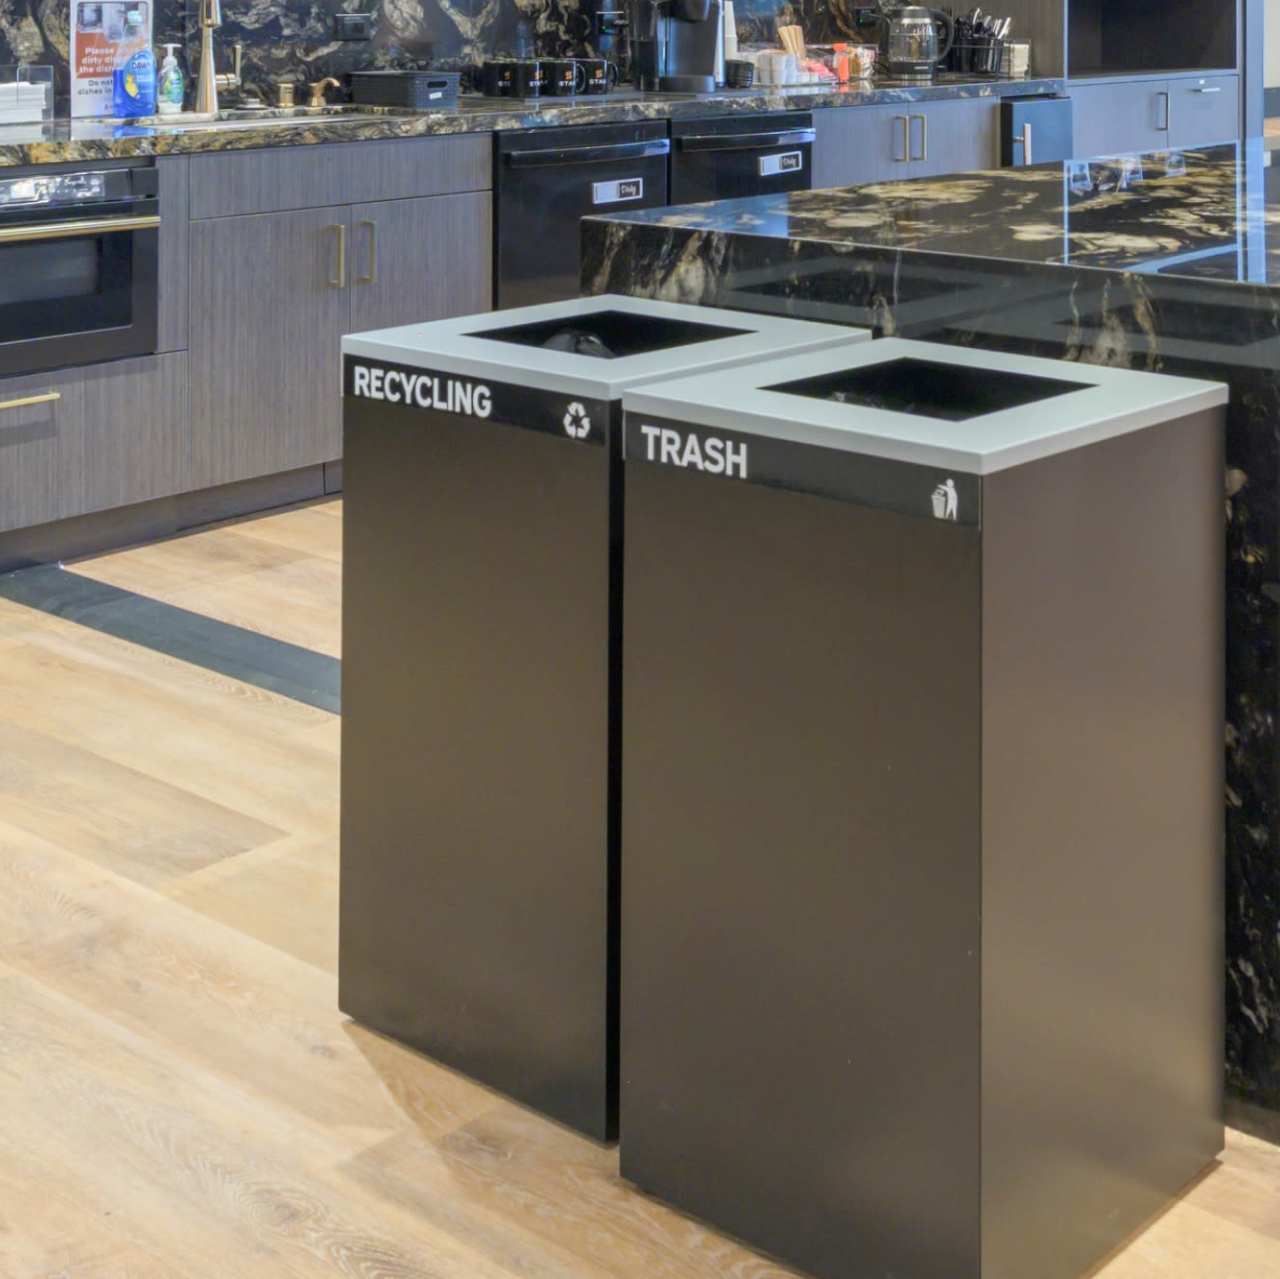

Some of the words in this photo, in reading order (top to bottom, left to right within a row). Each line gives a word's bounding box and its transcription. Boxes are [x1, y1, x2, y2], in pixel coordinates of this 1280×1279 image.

[79, 65, 94, 73] the
[354, 365, 493, 418] RECYCLING
[640, 424, 747, 479] TRASH
